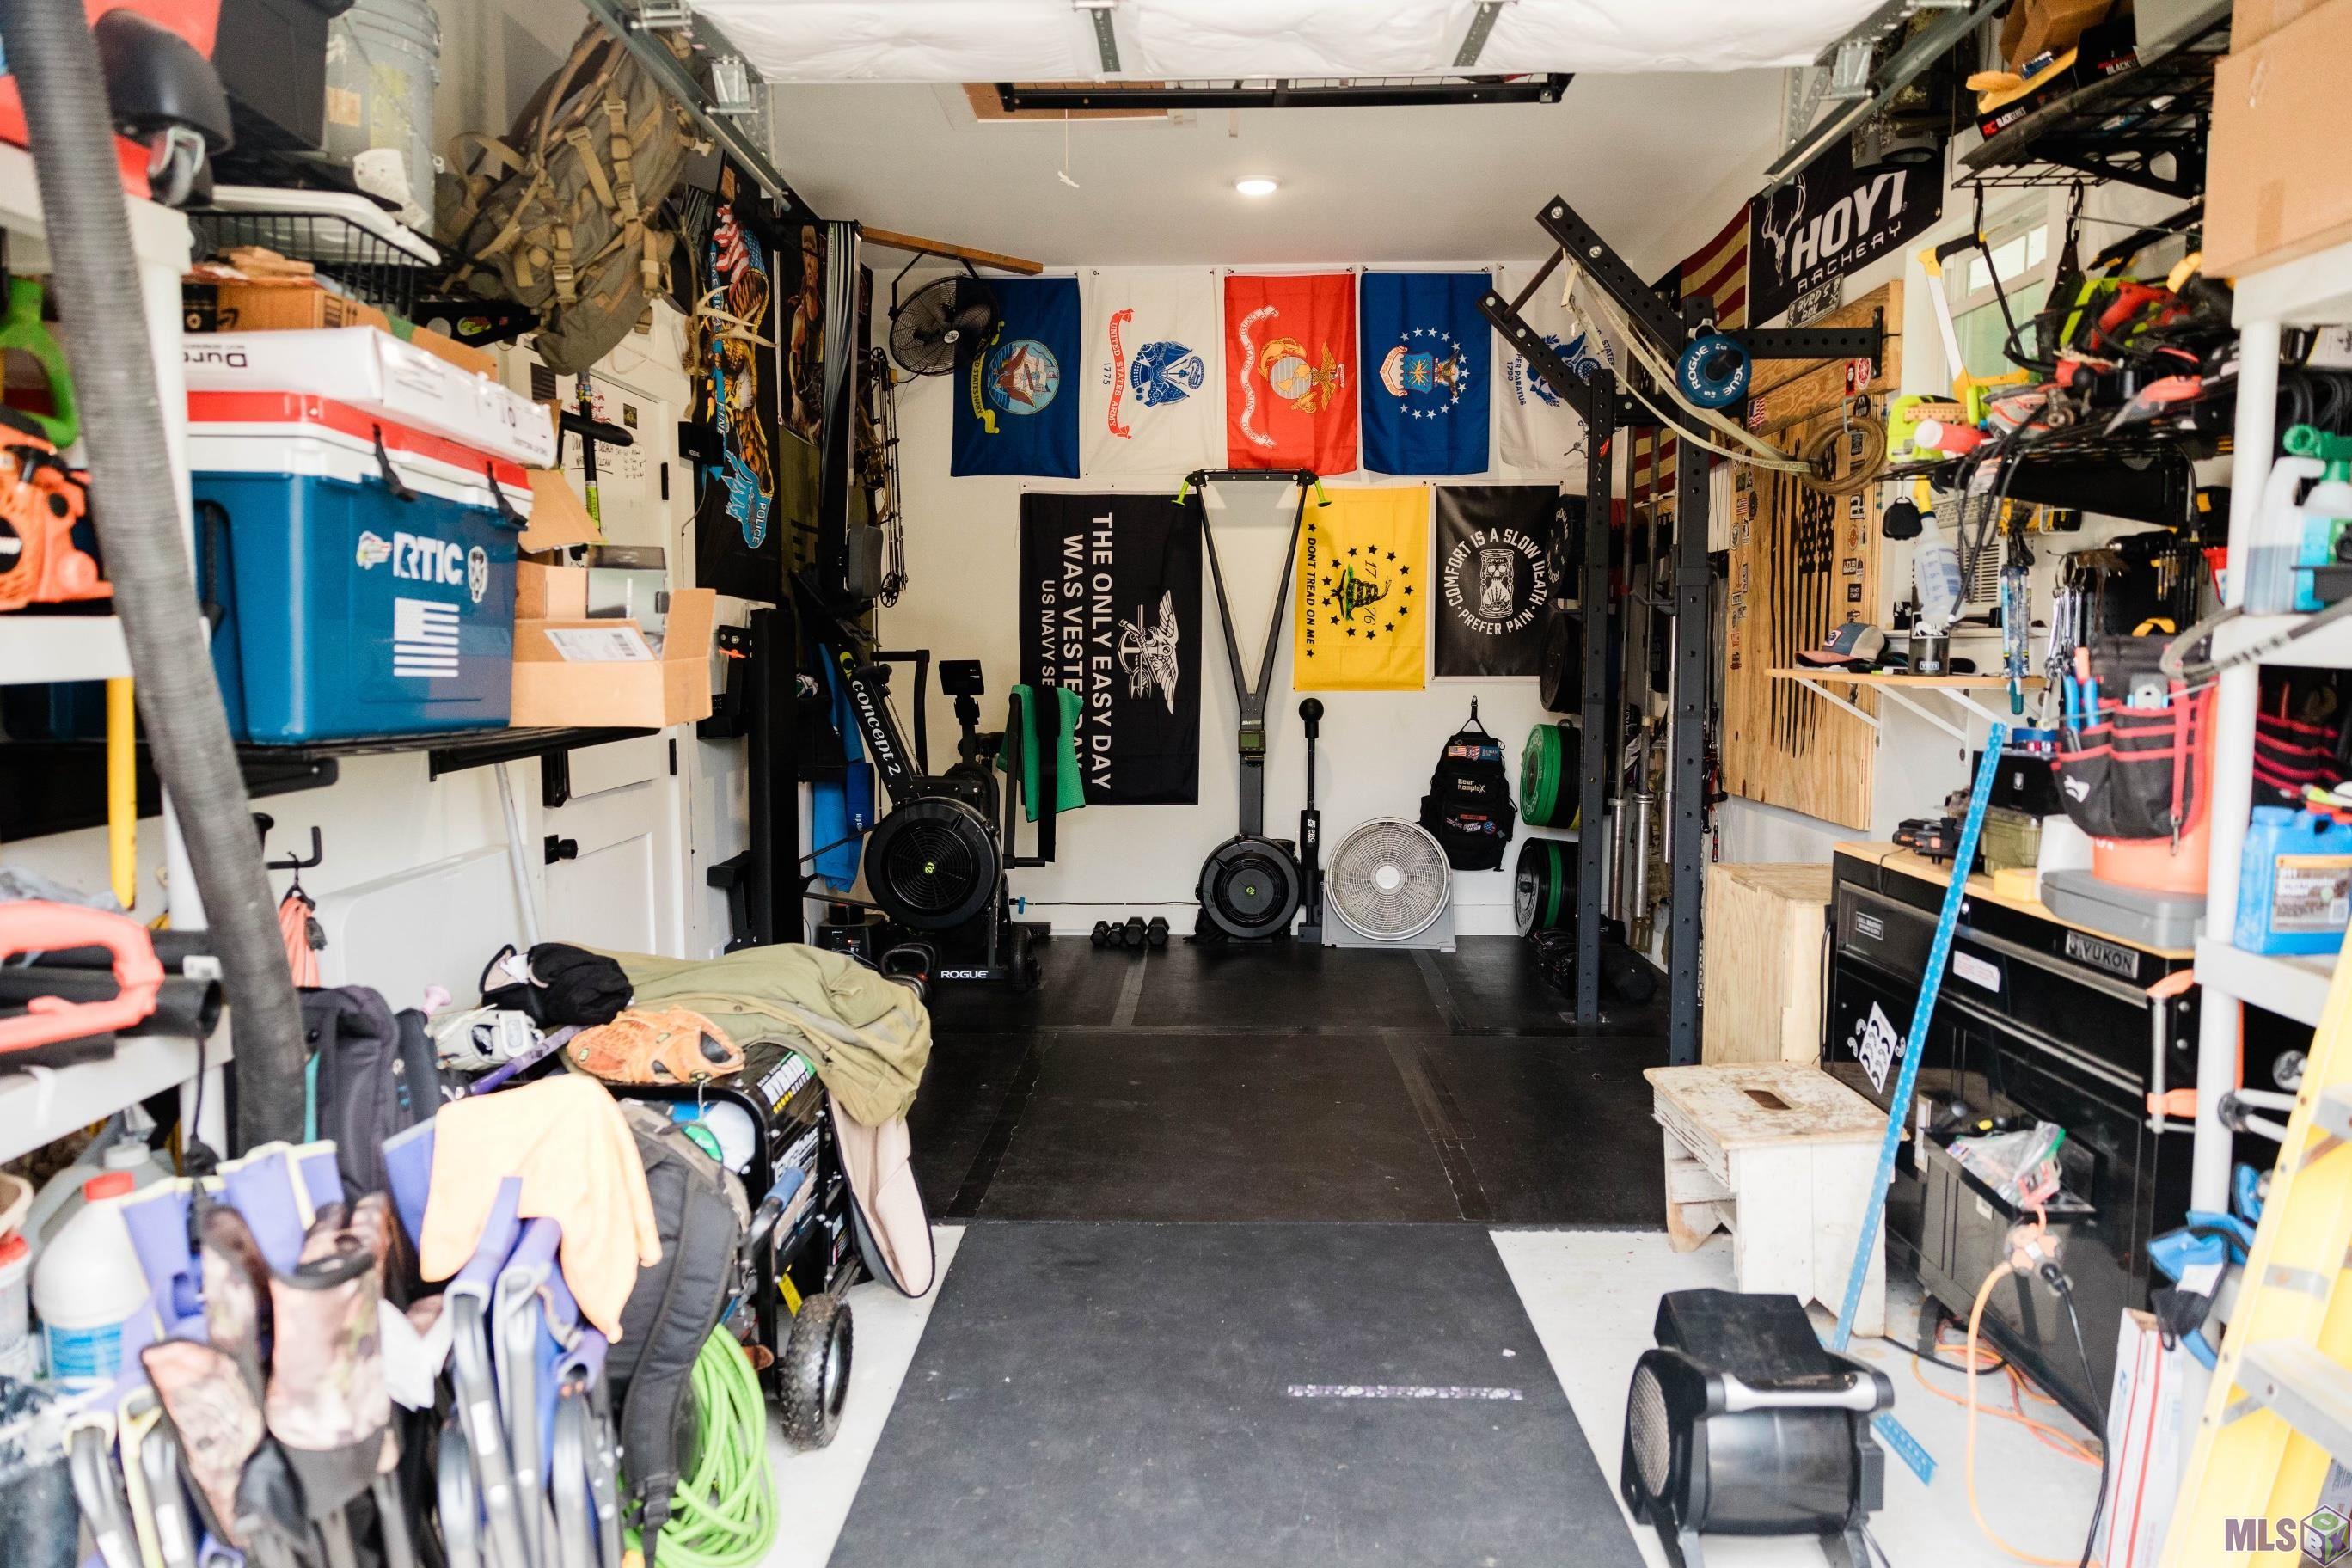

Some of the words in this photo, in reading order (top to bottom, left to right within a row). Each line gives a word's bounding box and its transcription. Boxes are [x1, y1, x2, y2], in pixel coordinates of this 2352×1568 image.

[1791, 170, 1907, 279] HOYT
[1798, 221, 1901, 293] ARCHERY
[1110, 322, 1120, 356] UNITED
[1103, 362, 1112, 385] 1775
[1243, 343, 1254, 371] STATES
[1688, 345, 1709, 390] ROGUE
[1115, 361, 1124, 396] STATES
[1515, 370, 1526, 406] PARATUS
[973, 395, 983, 415] NAVY
[1109, 401, 1119, 426] ARMY
[1244, 383, 1255, 413] MARINE
[1243, 422, 1258, 441] CORPS
[752, 502, 768, 544] POLICE
[1093, 511, 1112, 565] THE
[393, 531, 464, 585] RTIC
[1063, 534, 1084, 597] WAS
[1308, 537, 1317, 569] DONT
[1364, 560, 1377, 579] 17
[1444, 540, 1472, 607] COMFORT
[1470, 530, 1486, 548] IS
[1490, 527, 1499, 543] A
[1503, 528, 1542, 560] SLOW
[1529, 560, 1547, 606] DEATH
[1041, 580, 1056, 605] US
[1307, 572, 1316, 607] TREAD
[1092, 573, 1112, 648] ONLY
[1307, 609, 1315, 626] ON
[1363, 607, 1376, 625] 76
[1458, 609, 1502, 635] PREFER
[1506, 609, 1534, 634] PAIN
[1041, 610, 1056, 661] NAVY
[1306, 629, 1315, 645] ME
[1041, 666, 1056, 687] SE
[1092, 656, 1112, 726] EASY
[852, 680, 895, 762] concept
[888, 763, 901, 776] 2
[1091, 735, 1112, 789] DAY
[2083, 940, 2132, 971] YUKON
[940, 970, 989, 979] ROGUE
